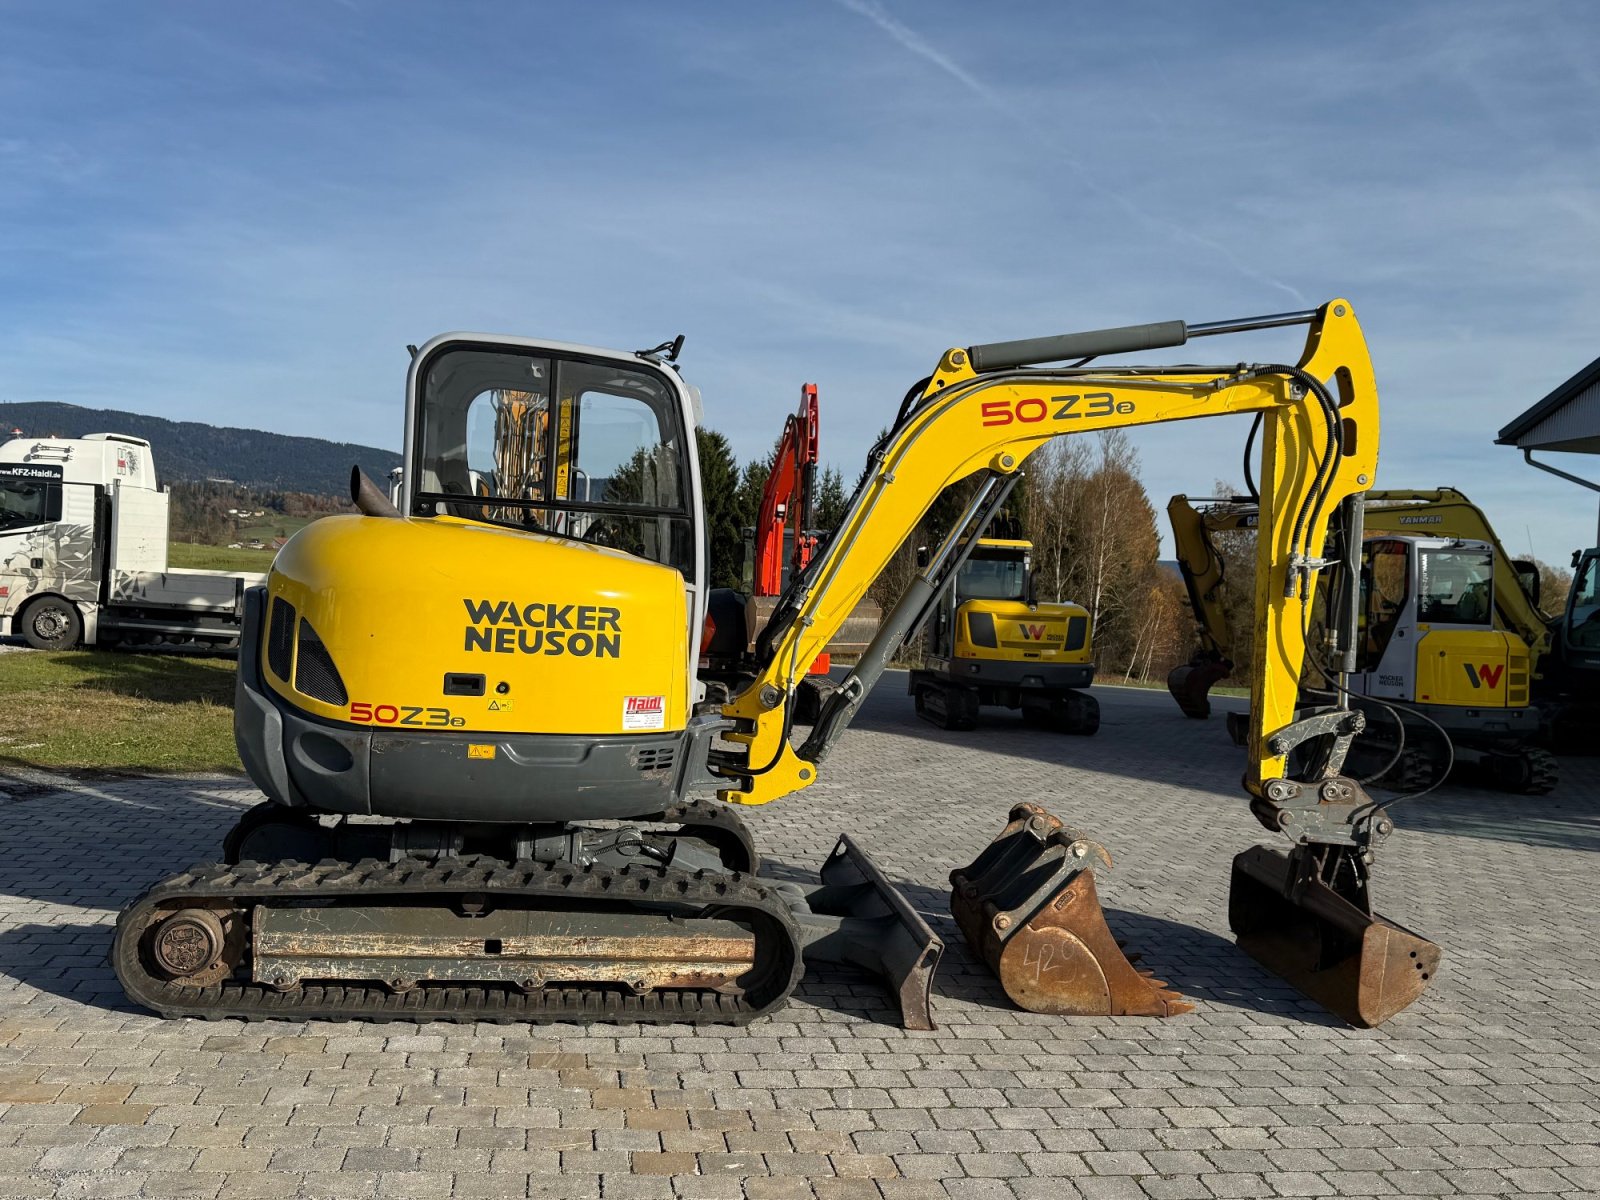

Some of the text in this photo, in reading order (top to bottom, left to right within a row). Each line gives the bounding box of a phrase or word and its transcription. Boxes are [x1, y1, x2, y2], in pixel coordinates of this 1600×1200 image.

[1399, 515, 1442, 524] YANMAR
[463, 599, 622, 632] WACKER
[464, 626, 621, 658] NEUSON
